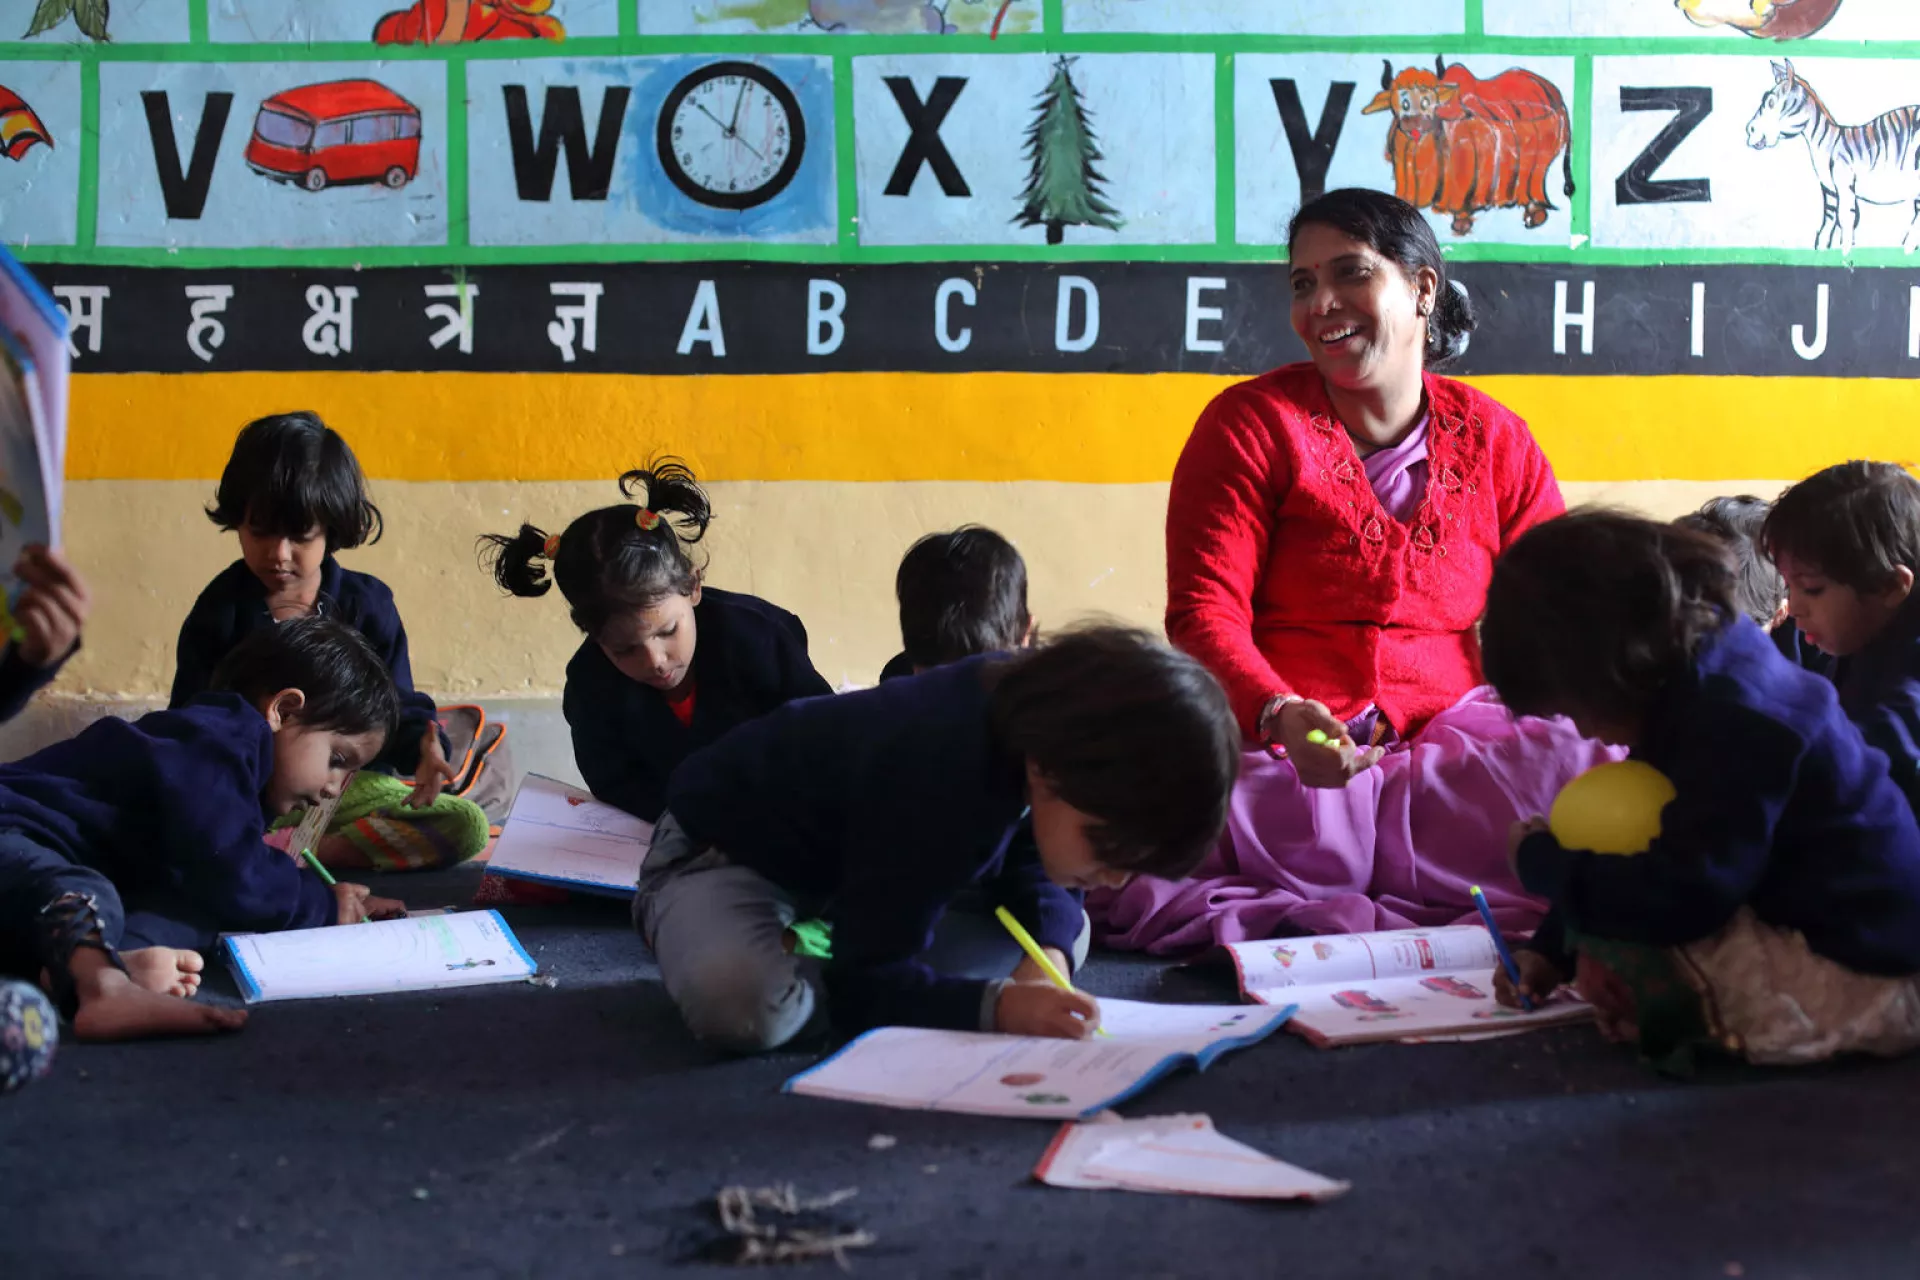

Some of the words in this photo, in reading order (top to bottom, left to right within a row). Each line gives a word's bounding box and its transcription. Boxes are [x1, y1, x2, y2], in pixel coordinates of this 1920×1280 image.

[139, 89, 234, 220] V
[501, 84, 632, 202] W
[882, 76, 971, 197] X
[1269, 78, 1357, 206] Y
[1615, 86, 1713, 205] Z
[51, 285, 111, 359] स
[184, 284, 235, 362] ह
[302, 284, 358, 357] क्ष
[424, 283, 480, 354] त्र
[547, 281, 604, 362] ज्ञ
[676, 279, 726, 357] A
[806, 278, 847, 356] B
[934, 276, 977, 353] C
[1054, 275, 1100, 353] D
[1184, 276, 1227, 353] E
[1553, 279, 1596, 356] H
[1690, 281, 1706, 358] I
[1790, 282, 1830, 361] J
